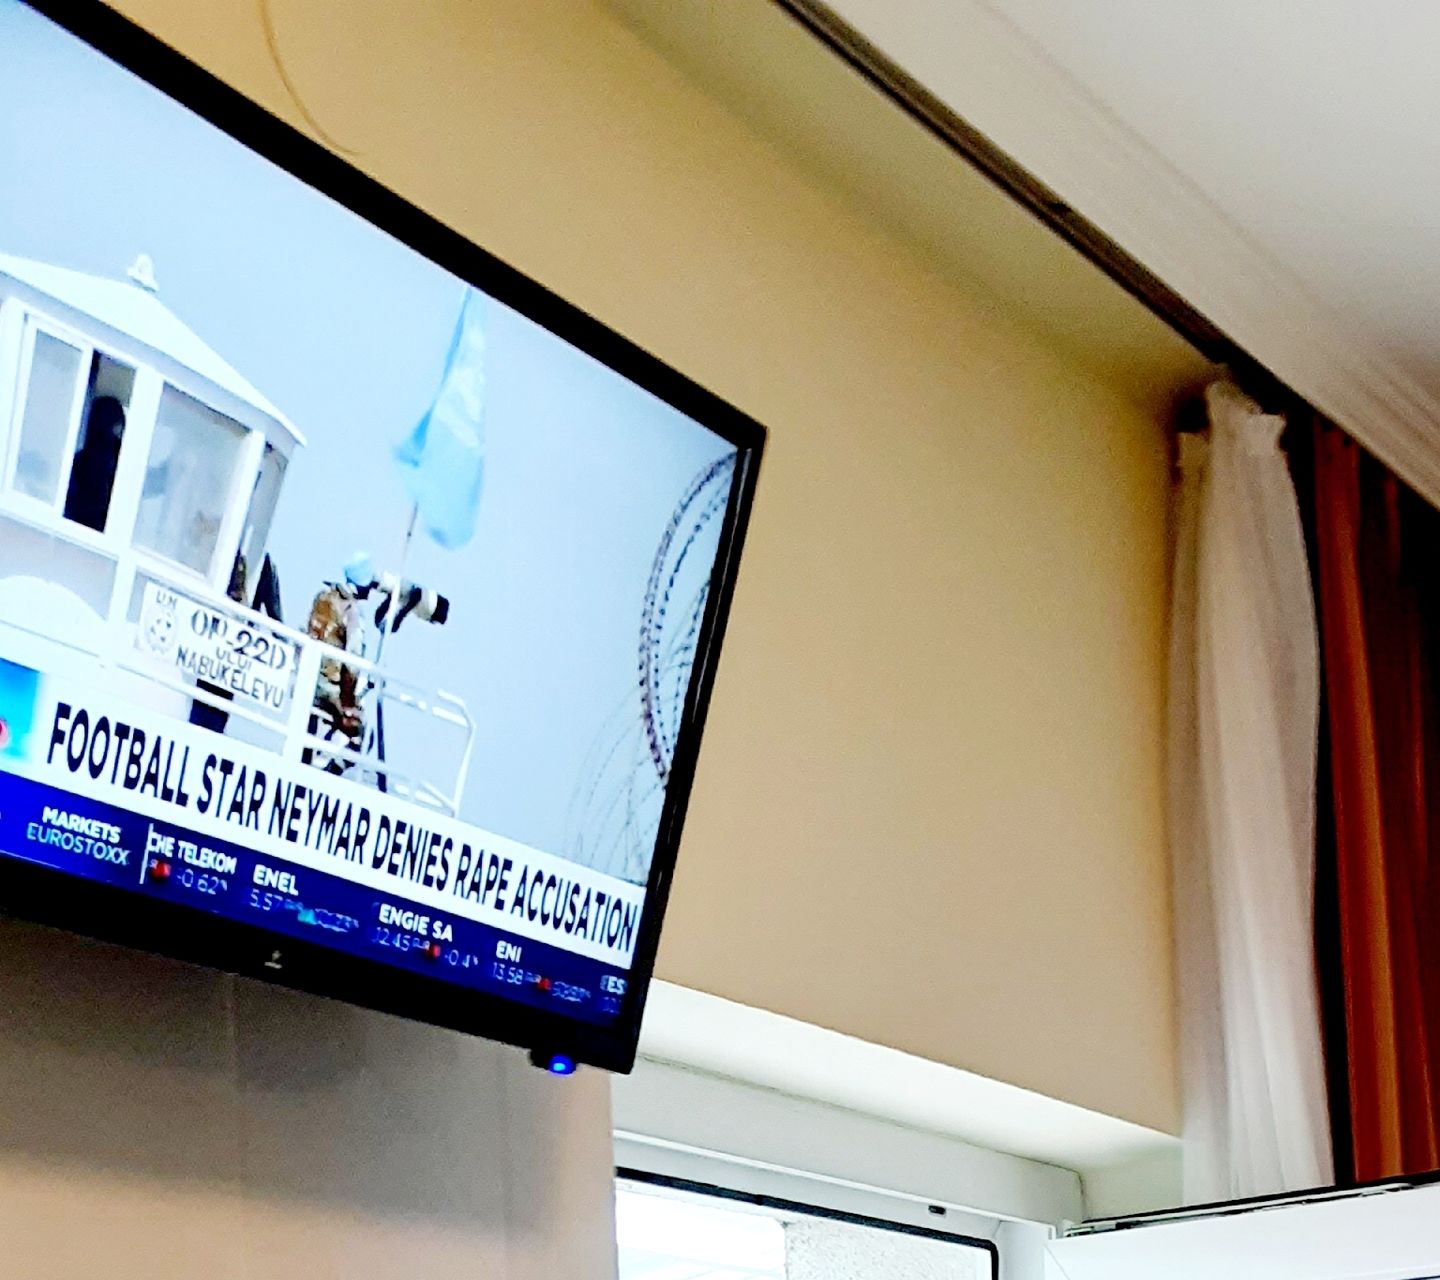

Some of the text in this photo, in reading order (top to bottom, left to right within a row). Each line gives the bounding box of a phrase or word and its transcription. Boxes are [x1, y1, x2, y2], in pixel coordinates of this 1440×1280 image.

[42, 806, 121, 844] MARKETS
[47, 701, 638, 953] FOOTBALL STAR NEYMAR DENIES RAPE ACCUSATION
[26, 822, 130, 867] EUROSTOXX
[177, 840, 237, 875] TELEKOM
[253, 864, 299, 896] ENEL
[379, 903, 430, 936] ENGIE
[432, 920, 453, 943] SA
[496, 940, 522, 963] ENI
